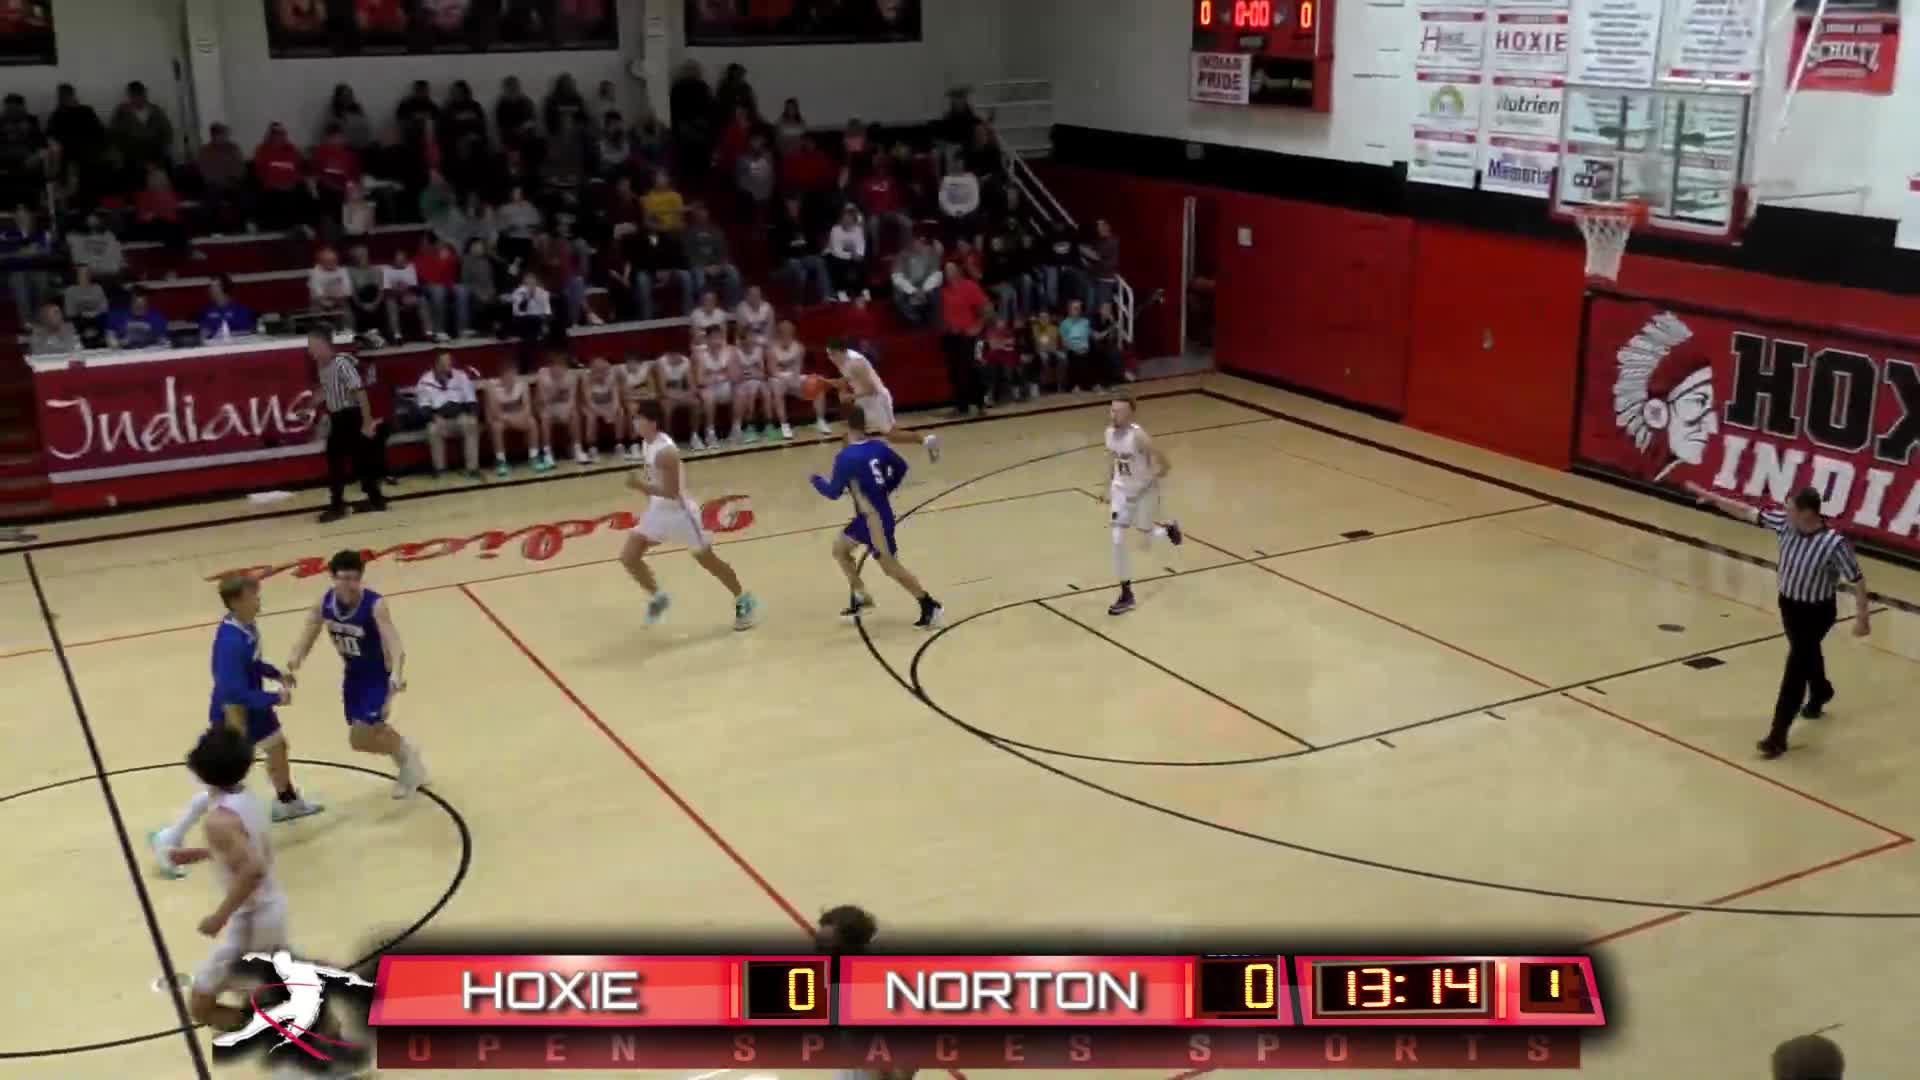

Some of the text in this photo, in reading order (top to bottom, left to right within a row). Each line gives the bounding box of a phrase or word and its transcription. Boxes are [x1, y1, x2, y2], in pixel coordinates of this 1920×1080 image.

[1200, 1, 1212, 25] 0
[1301, 2, 1313, 28] 0
[1496, 30, 1568, 51] HOXIE
[1198, 71, 1242, 90] PRIDE
[1488, 158, 1550, 184] Memoria
[46, 376, 316, 460] Indians
